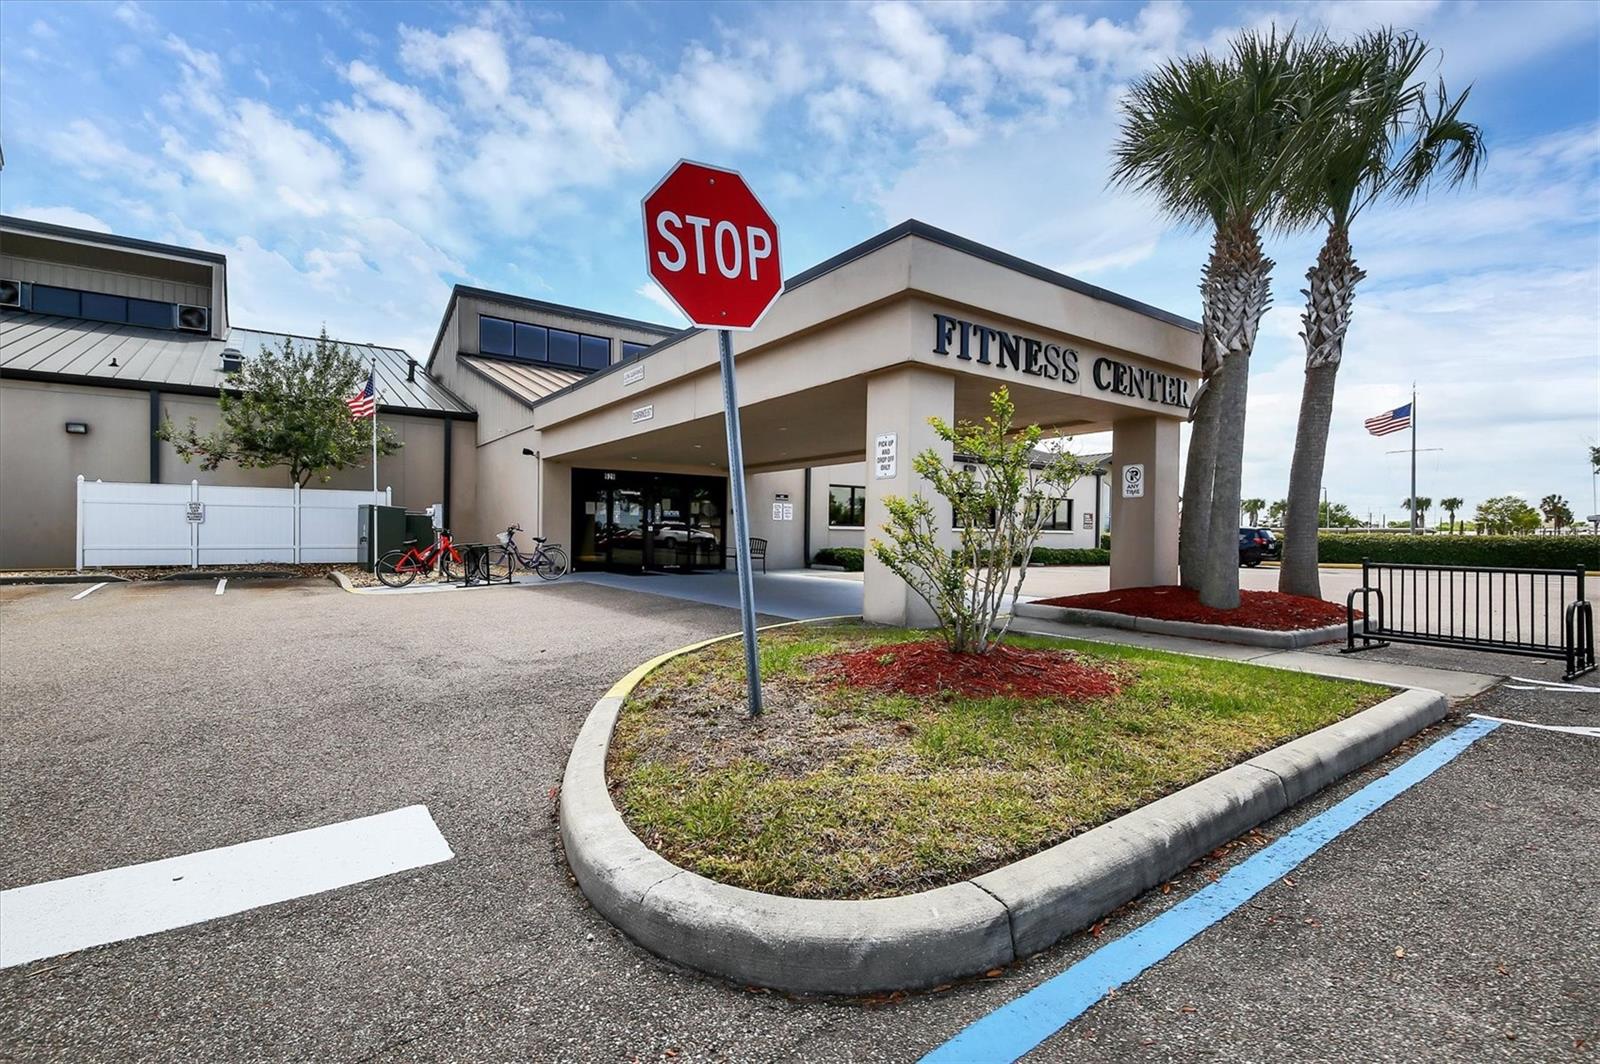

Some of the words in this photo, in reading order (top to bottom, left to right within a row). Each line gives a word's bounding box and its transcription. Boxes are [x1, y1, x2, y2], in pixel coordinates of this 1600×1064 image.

[656, 210, 772, 281] STOP
[933, 314, 1079, 384] FITNESS
[1093, 357, 1190, 409] CENTER
